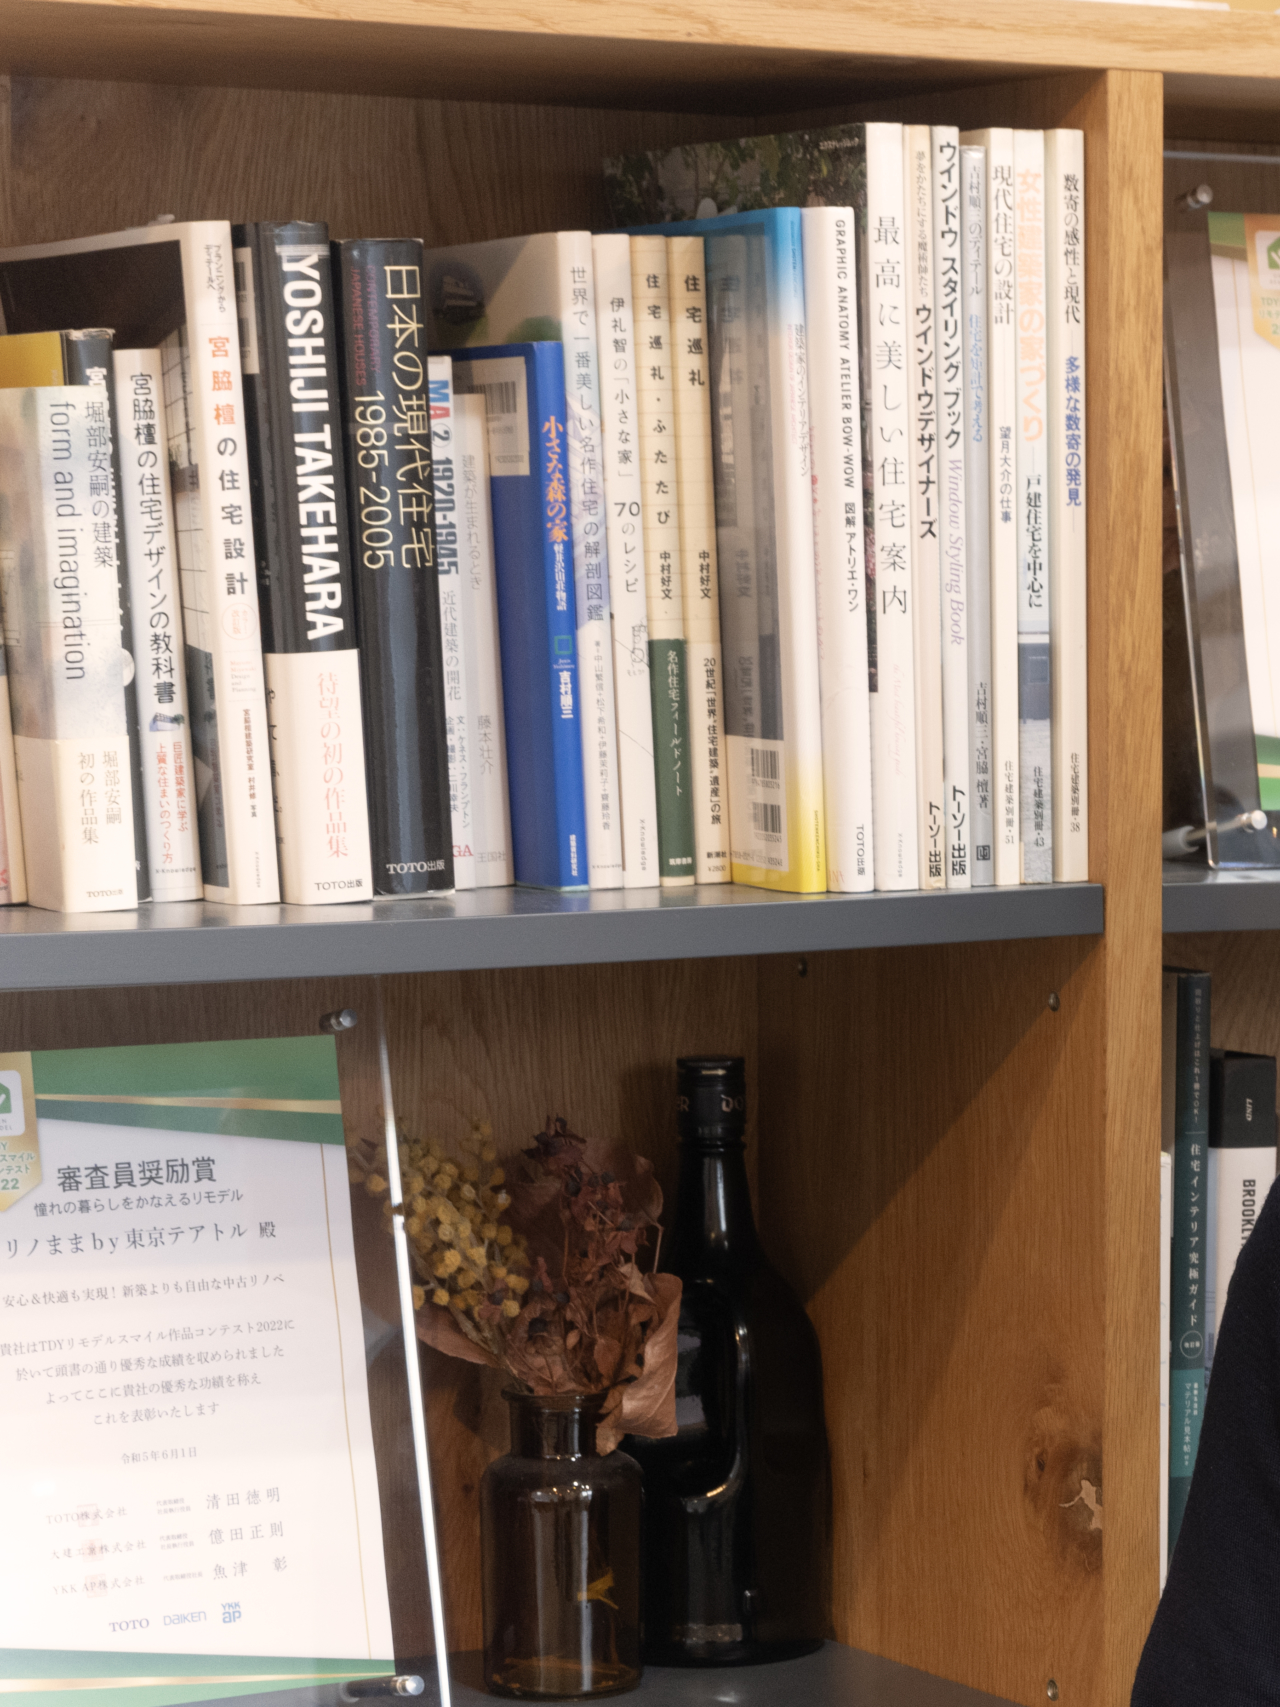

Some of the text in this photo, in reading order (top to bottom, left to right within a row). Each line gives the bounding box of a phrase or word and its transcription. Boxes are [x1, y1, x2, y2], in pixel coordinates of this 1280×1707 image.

[915, 151, 929, 298] 夢をかたちにする魔術師たち
[968, 165, 983, 297] 吉村順三のディテール
[993, 165, 1014, 325] 現代住宅の設計
[1063, 173, 1081, 325] 数寄の感性と現代
[351, 265, 367, 386] JAPANESE HOUSES
[365, 264, 382, 374] CONTEMPORARY
[684, 275, 706, 387] 住宅巡礼
[835, 219, 855, 489] GRAPHIC ANATOMY ATELIER BOW-WOW
[939, 141, 962, 449] ウインドウ スタイリング ブック
[1017, 168, 1046, 442] 女性建築家の家づくり
[281, 253, 344, 640] YOSHIJI TAKEHARA
[383, 264, 434, 569] 日本の現代住宅
[570, 266, 605, 621] 世界で一番美しい名作住宅の解剖図鑑
[610, 297, 641, 593] 伊礼智の「小さな家」 70のレシピ
[646, 274, 671, 524] 住宅巡礼・ふたたび
[873, 215, 907, 615] 最高に美しい住宅案内
[915, 303, 938, 539] ウインドウデザイナーズ
[1065, 356, 1082, 507] 多様な数寄の発見
[85, 401, 114, 568] 堀部安嗣の建築
[208, 335, 249, 596] 宮脇檀の住宅設計
[354, 390, 395, 570] 1985-2005
[431, 456, 460, 576] 1920-1945
[541, 415, 569, 543] 小さな森の家
[999, 426, 1013, 524] 望月大介の仕事
[50, 402, 87, 681] form and imagination
[130, 372, 176, 704] 宮脇檀の住宅デザインの教科書
[659, 551, 672, 600] 中村好文
[698, 551, 711, 600] 中村好文
[845, 502, 859, 612] 図解 アトリエ・ワン
[945, 458, 965, 646] Window Styling Book
[1025, 474, 1043, 609] 戸建住宅を中心に
[442, 589, 462, 701] 近代建築の開花
[317, 671, 349, 858] 待望の初の作品集
[477, 715, 494, 775] 藤本壮介
[666, 650, 683, 797] 名作住宅フィールドノート
[78, 752, 99, 845] 初の作品集
[102, 750, 122, 825] 堀部安嗣
[155, 742, 174, 865] 上質な住まいのつくり方
[172, 741, 188, 833] 巨匠建築家に学ぶ
[639, 818, 647, 871] X-Knowledge
[314, 878, 364, 892] TOTO出版
[386, 859, 446, 875] TOTO出版
[855, 823, 866, 876] TOTO出版
[33, 1188, 244, 1218] 憧れの暮らしをかなえるリモデル
[57, 1156, 217, 1193] 審査員奨励賞
[258, 1221, 277, 1239] 殿
[1241, 1178, 1257, 1246] BROOKL
[1188, 1143, 1201, 1327] 住宅インテリア究極ガイド
[15, 1344, 285, 1382] 於いて頭書の通り優秀な成績を収められました
[45, 1372, 262, 1406] よってここに貴社の優秀な功績を称え
[93, 1401, 221, 1426] これを表彰いたします
[45, 1505, 129, 1526] TOTO株式会社
[120, 1446, 199, 1465] 令和5年6月1日
[205, 1486, 282, 1511] 清田徳明
[208, 1521, 285, 1546] 億田正則
[108, 1617, 150, 1633] TOTO
[220, 1600, 242, 1611] YKK
